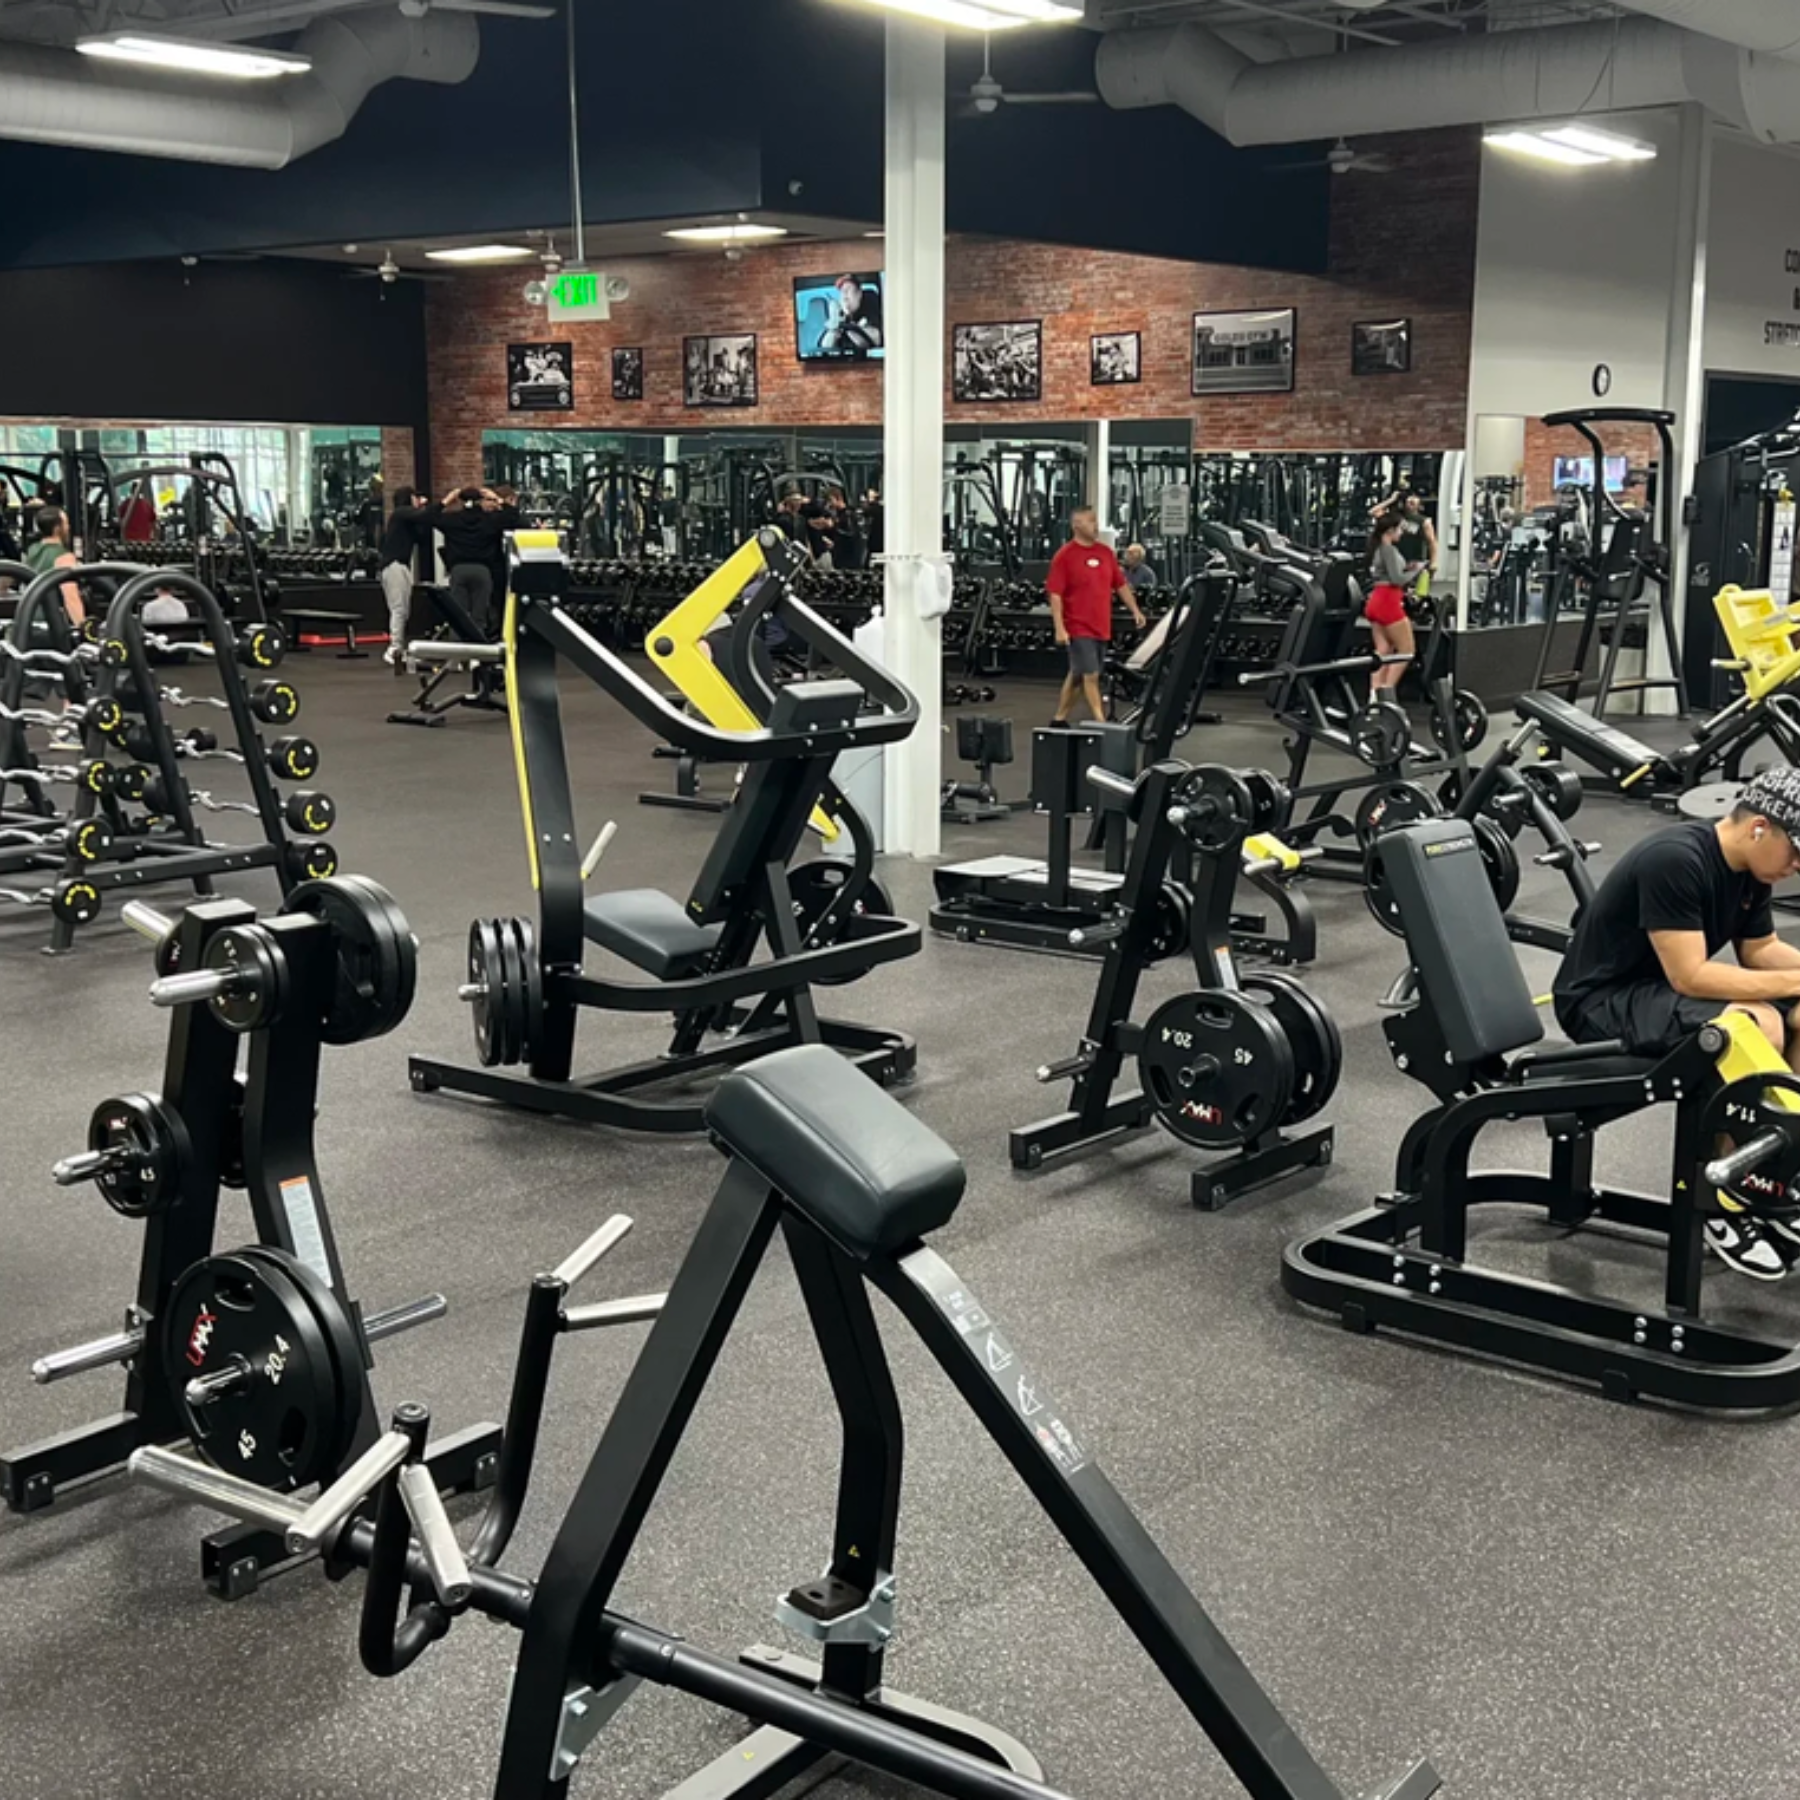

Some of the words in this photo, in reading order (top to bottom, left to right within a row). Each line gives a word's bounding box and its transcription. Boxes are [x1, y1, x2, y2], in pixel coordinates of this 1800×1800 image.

[558, 273, 598, 307] EXIT
[1162, 1027, 1193, 1048] 20.4
[1234, 1047, 1253, 1066] 45
[1726, 1102, 1756, 1123] 11.4
[264, 1333, 290, 1385] 20.4
[238, 1428, 256, 1459] 45
